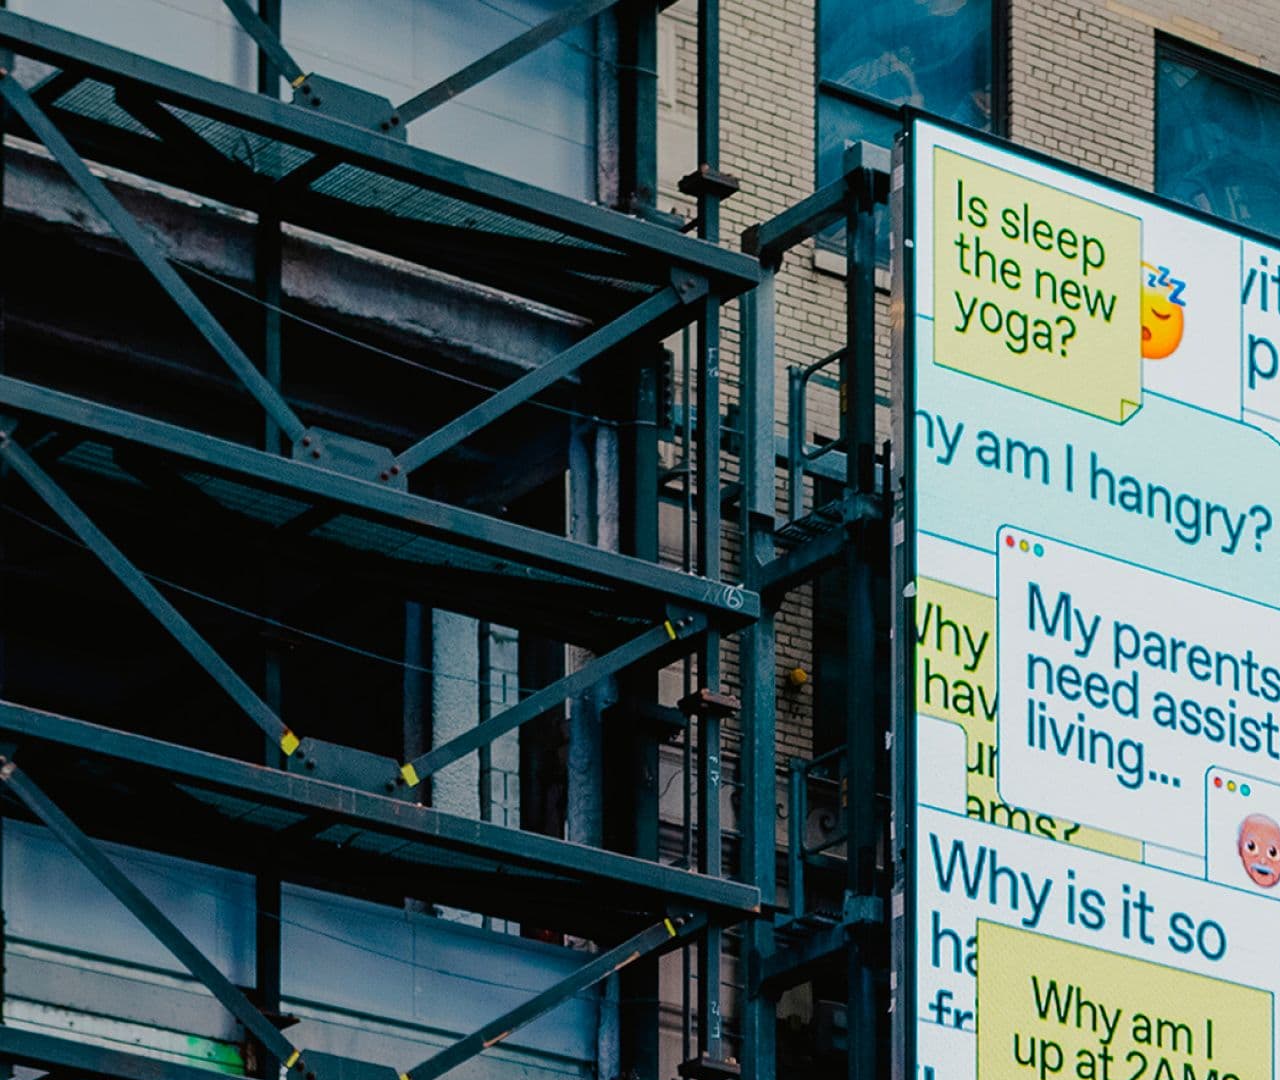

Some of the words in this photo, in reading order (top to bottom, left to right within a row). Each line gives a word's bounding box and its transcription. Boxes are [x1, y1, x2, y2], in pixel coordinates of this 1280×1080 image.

[955, 179, 988, 228] Is
[1001, 202, 1106, 275] sleep
[954, 232, 1022, 290] the
[1034, 265, 1118, 322] new
[954, 290, 1077, 358] yoga?
[975, 427, 1050, 486] am
[1065, 444, 1074, 493] I
[1090, 450, 1273, 555] hangry?
[1027, 581, 1102, 658] My
[1027, 653, 1139, 720] need
[1027, 695, 1182, 791] living...
[929, 832, 1054, 929] Why
[1066, 870, 1106, 932] is
[1121, 884, 1155, 946] it
[1167, 909, 1228, 963] so
[1031, 974, 1122, 1046] Why
[1131, 1009, 1194, 1056] am
[1207, 1018, 1214, 1060] I
